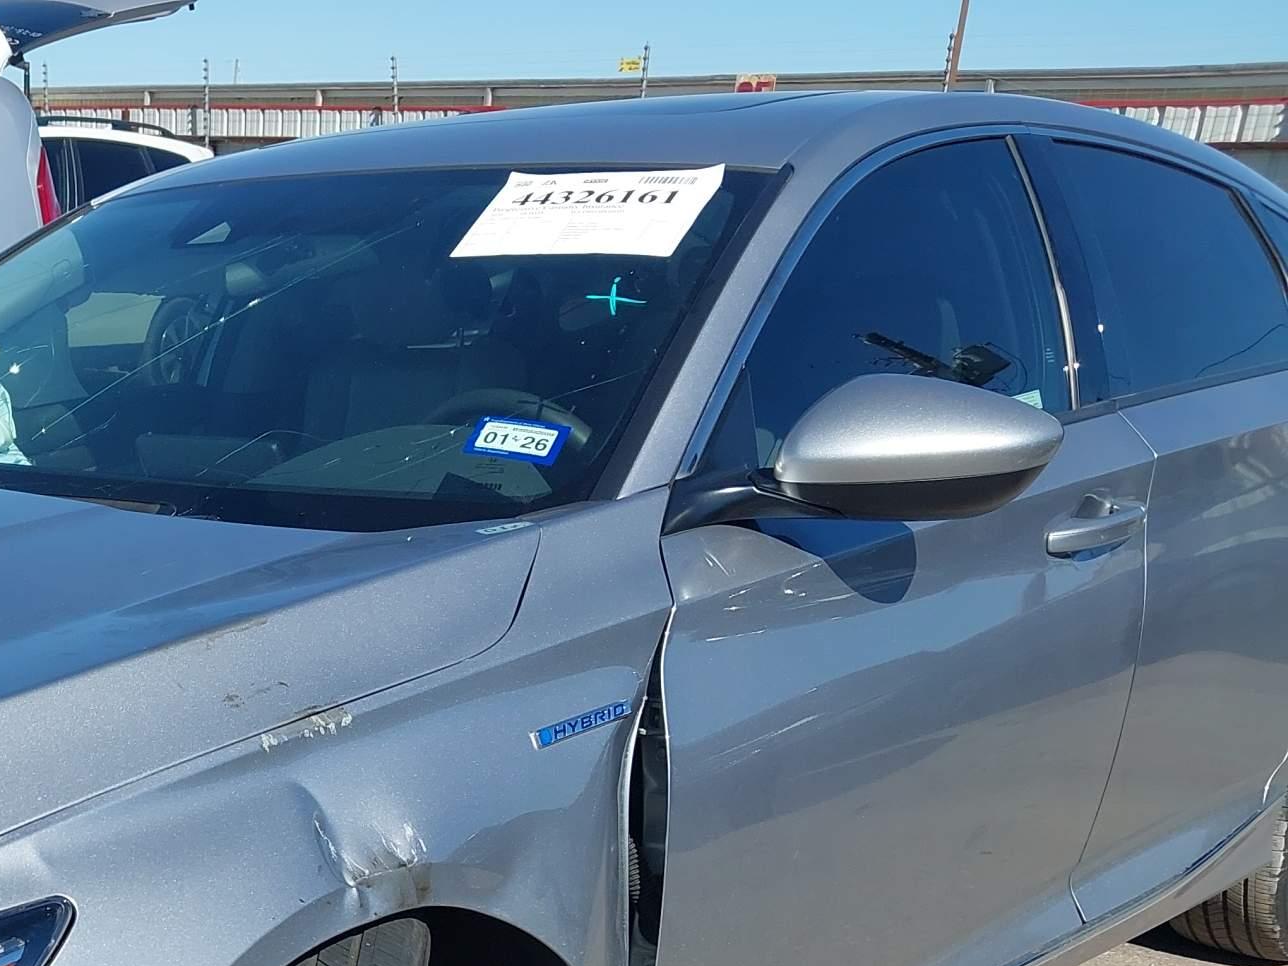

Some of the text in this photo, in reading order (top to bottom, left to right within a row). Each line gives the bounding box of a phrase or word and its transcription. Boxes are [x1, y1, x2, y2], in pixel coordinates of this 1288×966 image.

[511, 188, 680, 206] 44326161
[483, 431, 510, 446] 01
[519, 436, 550, 452] 26
[553, 703, 625, 739] HYBRID
